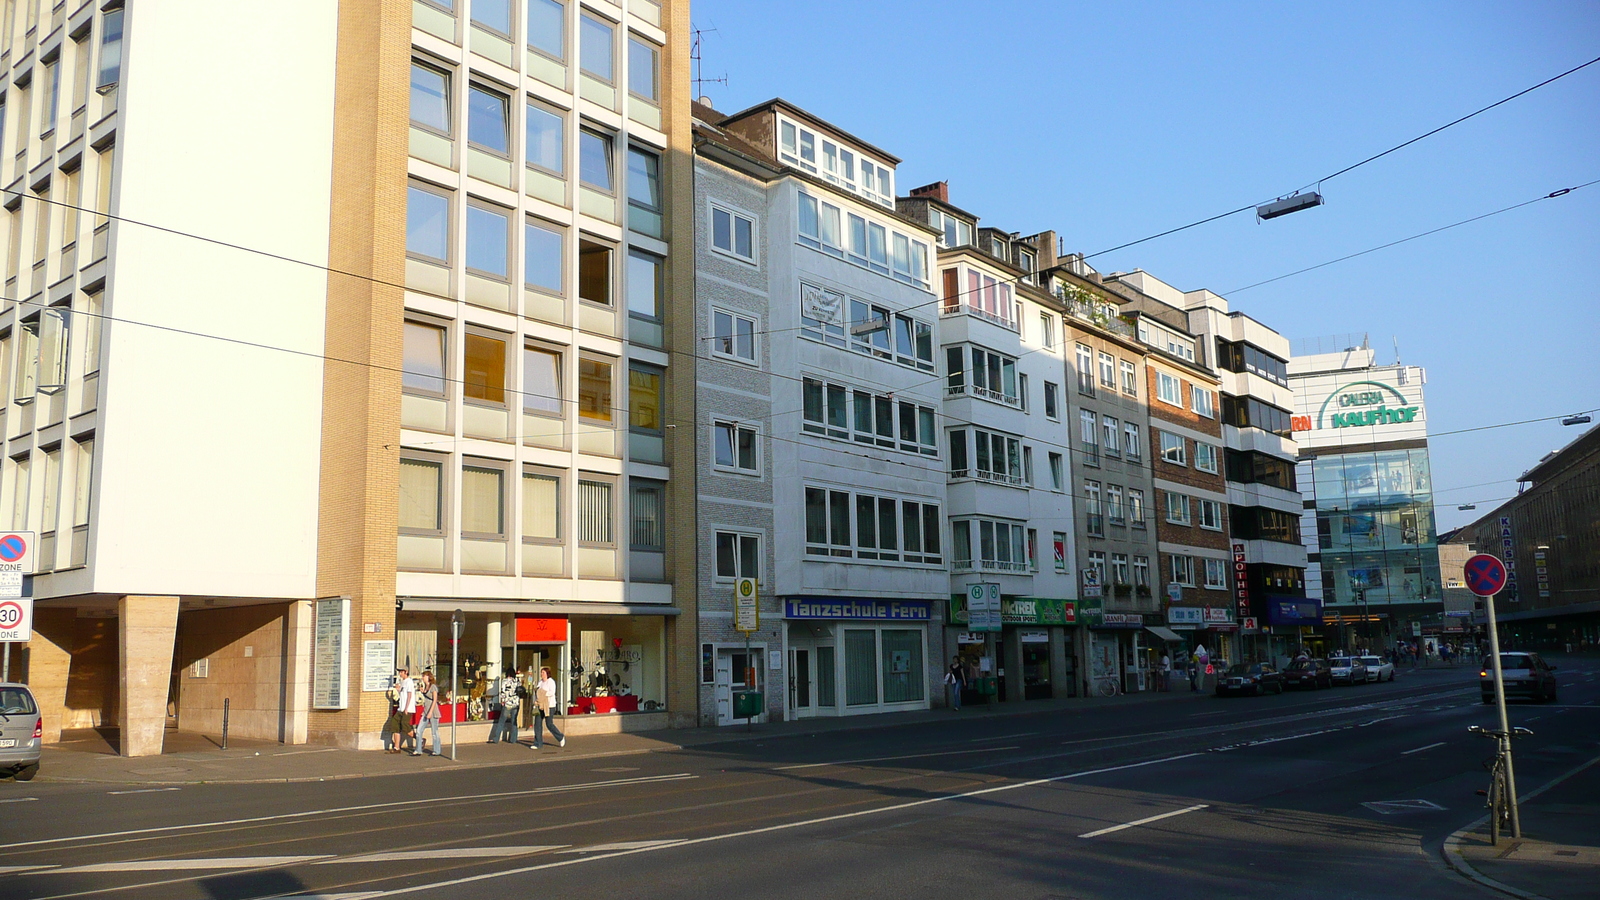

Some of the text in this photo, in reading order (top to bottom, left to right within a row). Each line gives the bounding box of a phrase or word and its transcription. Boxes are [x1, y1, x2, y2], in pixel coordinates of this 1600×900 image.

[1339, 391, 1385, 408] GALERIA
[1501, 517, 1517, 601] KARSTAD
[1234, 545, 1247, 617] APOTHEKE
[0, 609, 17, 623] 30
[788, 599, 928, 619] Tanzschule Fern
[0, 631, 19, 639] ONE
